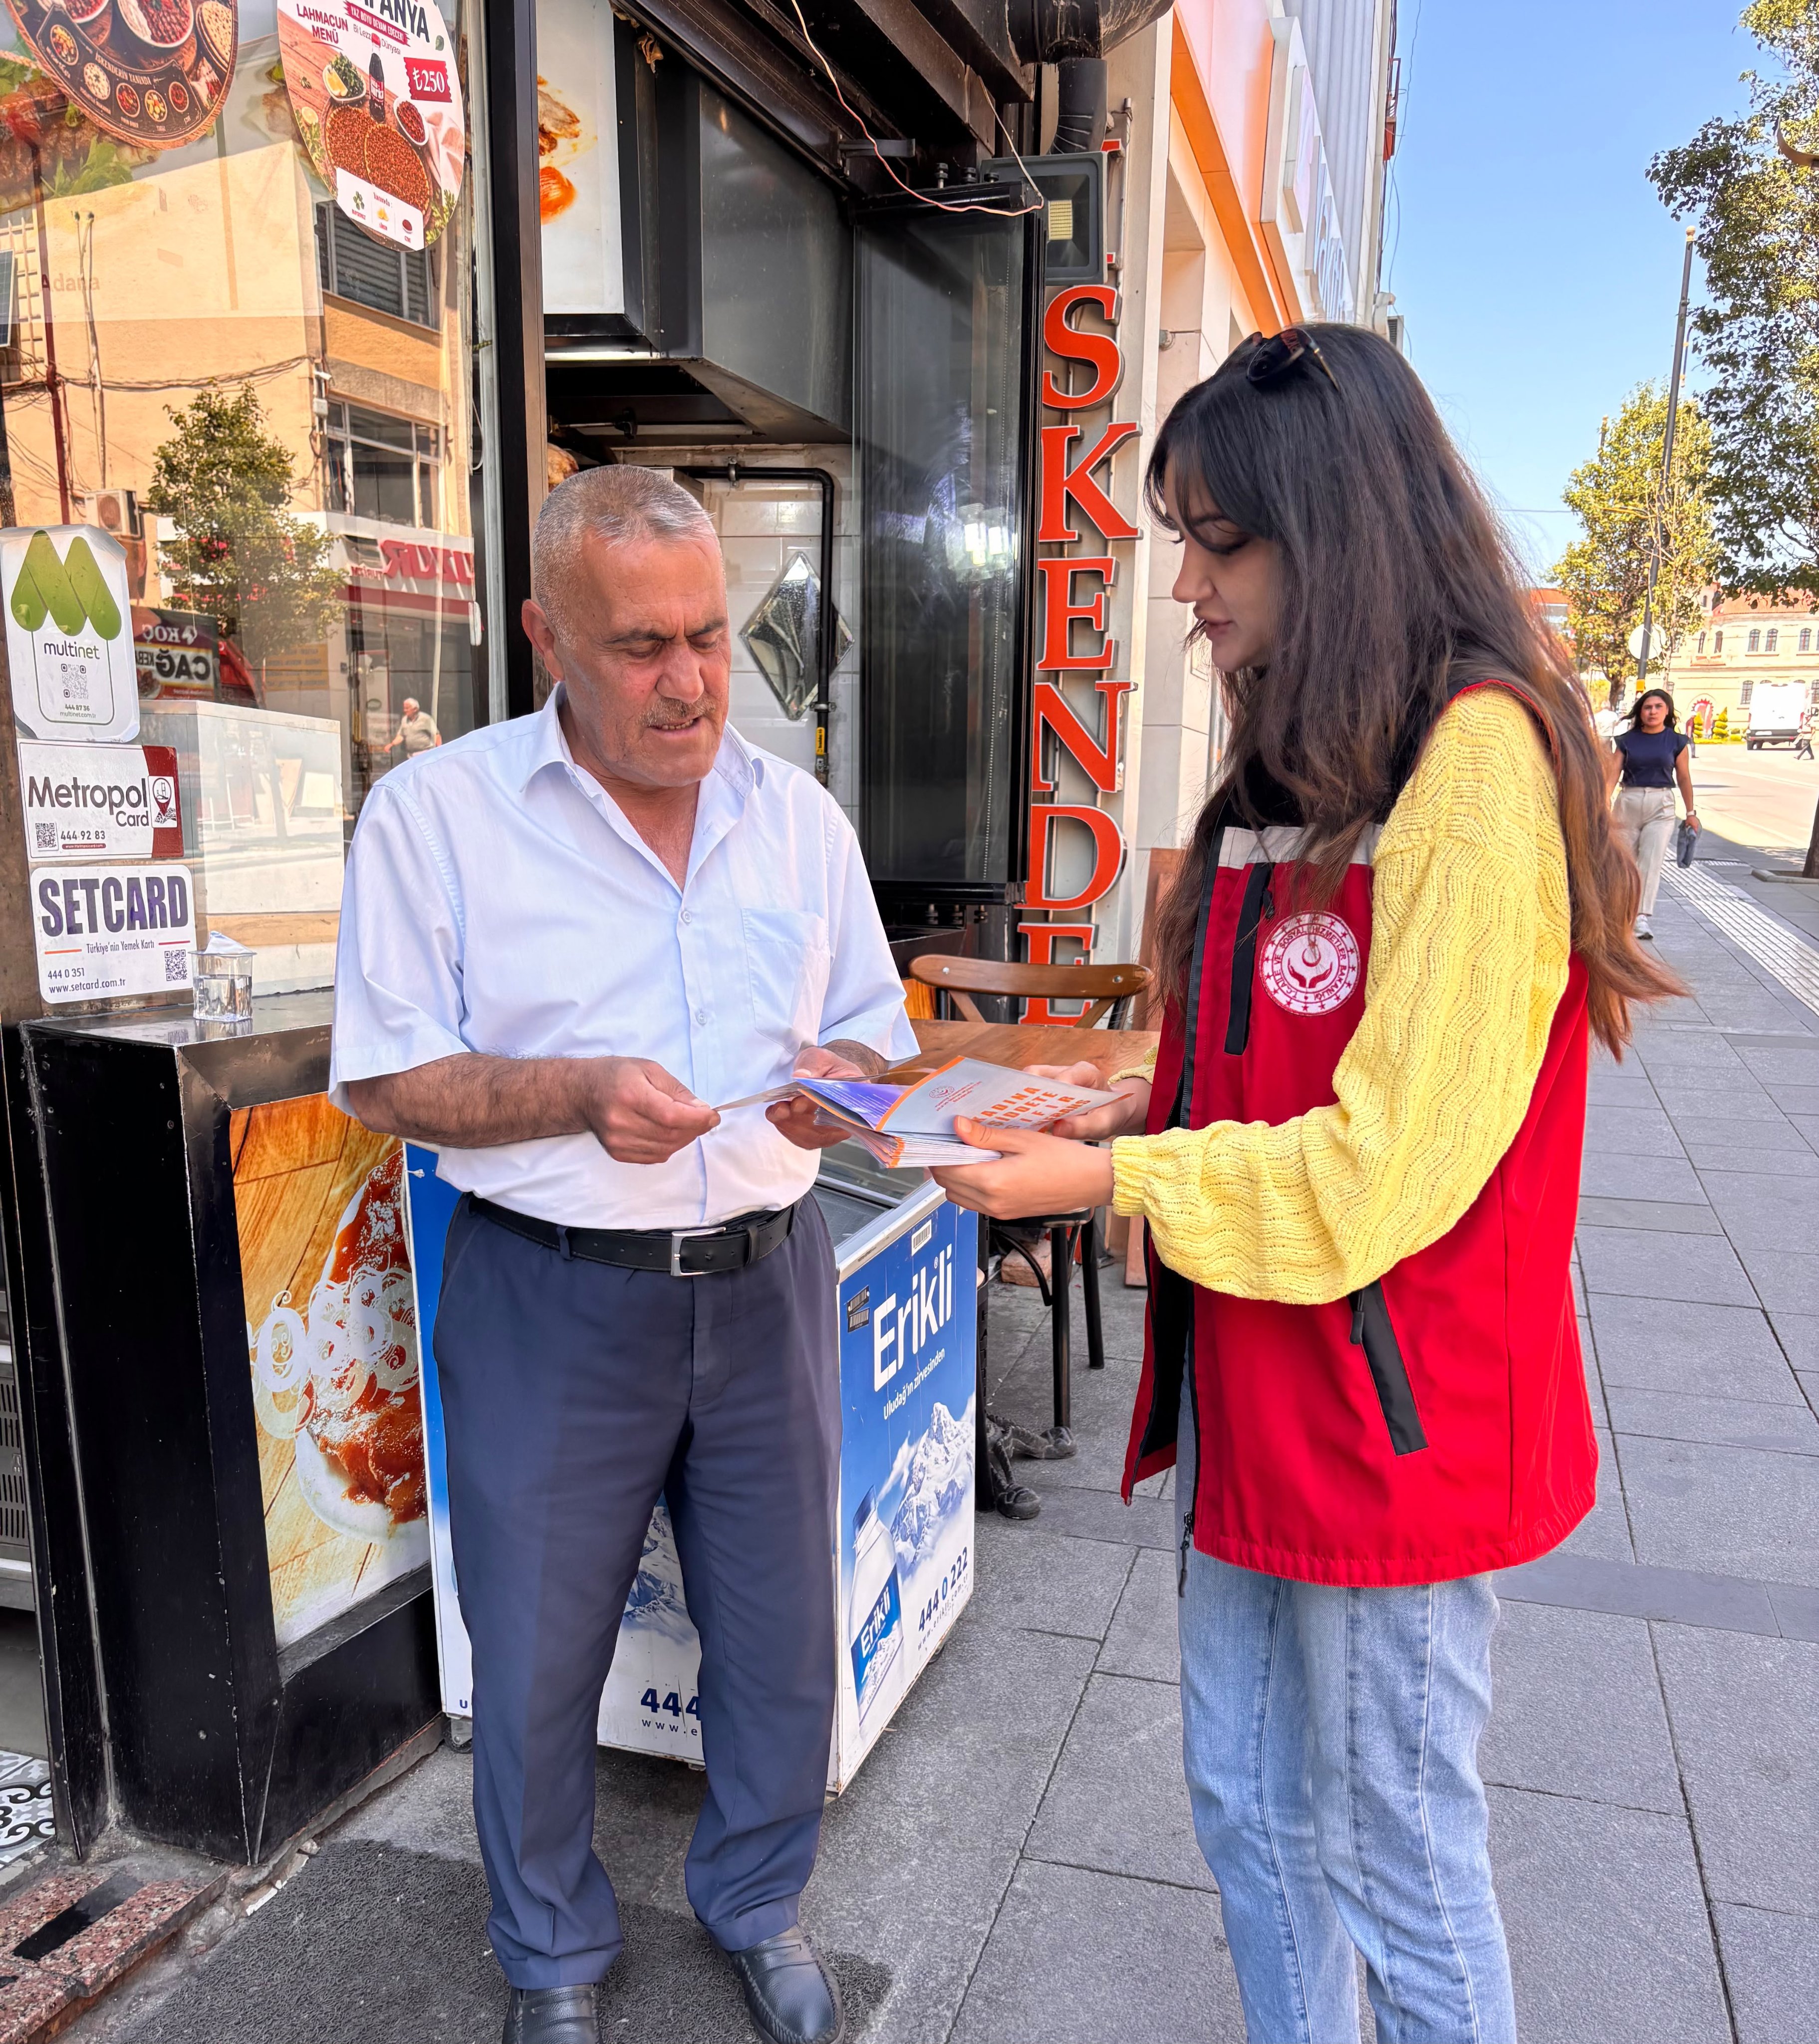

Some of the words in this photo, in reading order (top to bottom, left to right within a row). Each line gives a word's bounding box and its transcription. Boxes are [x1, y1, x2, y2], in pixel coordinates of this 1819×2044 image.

[296, 3, 349, 32] LAHMACUN
[350, 5, 360, 18] YAZ
[360, 10, 372, 25] BOYU
[373, 17, 387, 33] DEVAM
[311, 24, 339, 44] MENÜ
[353, 23, 359, 33] Bi
[381, 38, 401, 55] Dünyası
[413, 67, 445, 94] ₺250
[44, 641, 100, 660] multinet
[28, 776, 148, 815] Metropol
[116, 810, 149, 827] Card
[61, 830, 77, 840] 444
[80, 830, 92, 840] 92
[95, 830, 105, 840] 83
[38, 876, 189, 937] SETCARD
[86, 941, 119, 955] Türkiye'nin
[120, 940, 140, 951] Yemek
[141, 939, 154, 950] Kartı
[1274, 954, 1281, 965] VE
[1280, 926, 1307, 949] SOSYAL
[47, 970, 62, 980] 444
[64, 970, 69, 979] 0
[71, 968, 85, 978] 351
[49, 978, 126, 994] www.setcard.com.tr
[874, 1243, 953, 1392] Erikli
[883, 1381, 913, 1420] Uludağ'ın
[913, 1347, 945, 1390] zirvesinden
[919, 1588, 939, 1632] 444
[951, 1546, 968, 1590] 222
[860, 1586, 891, 1659] Erikli
[641, 1688, 701, 1721] 444
